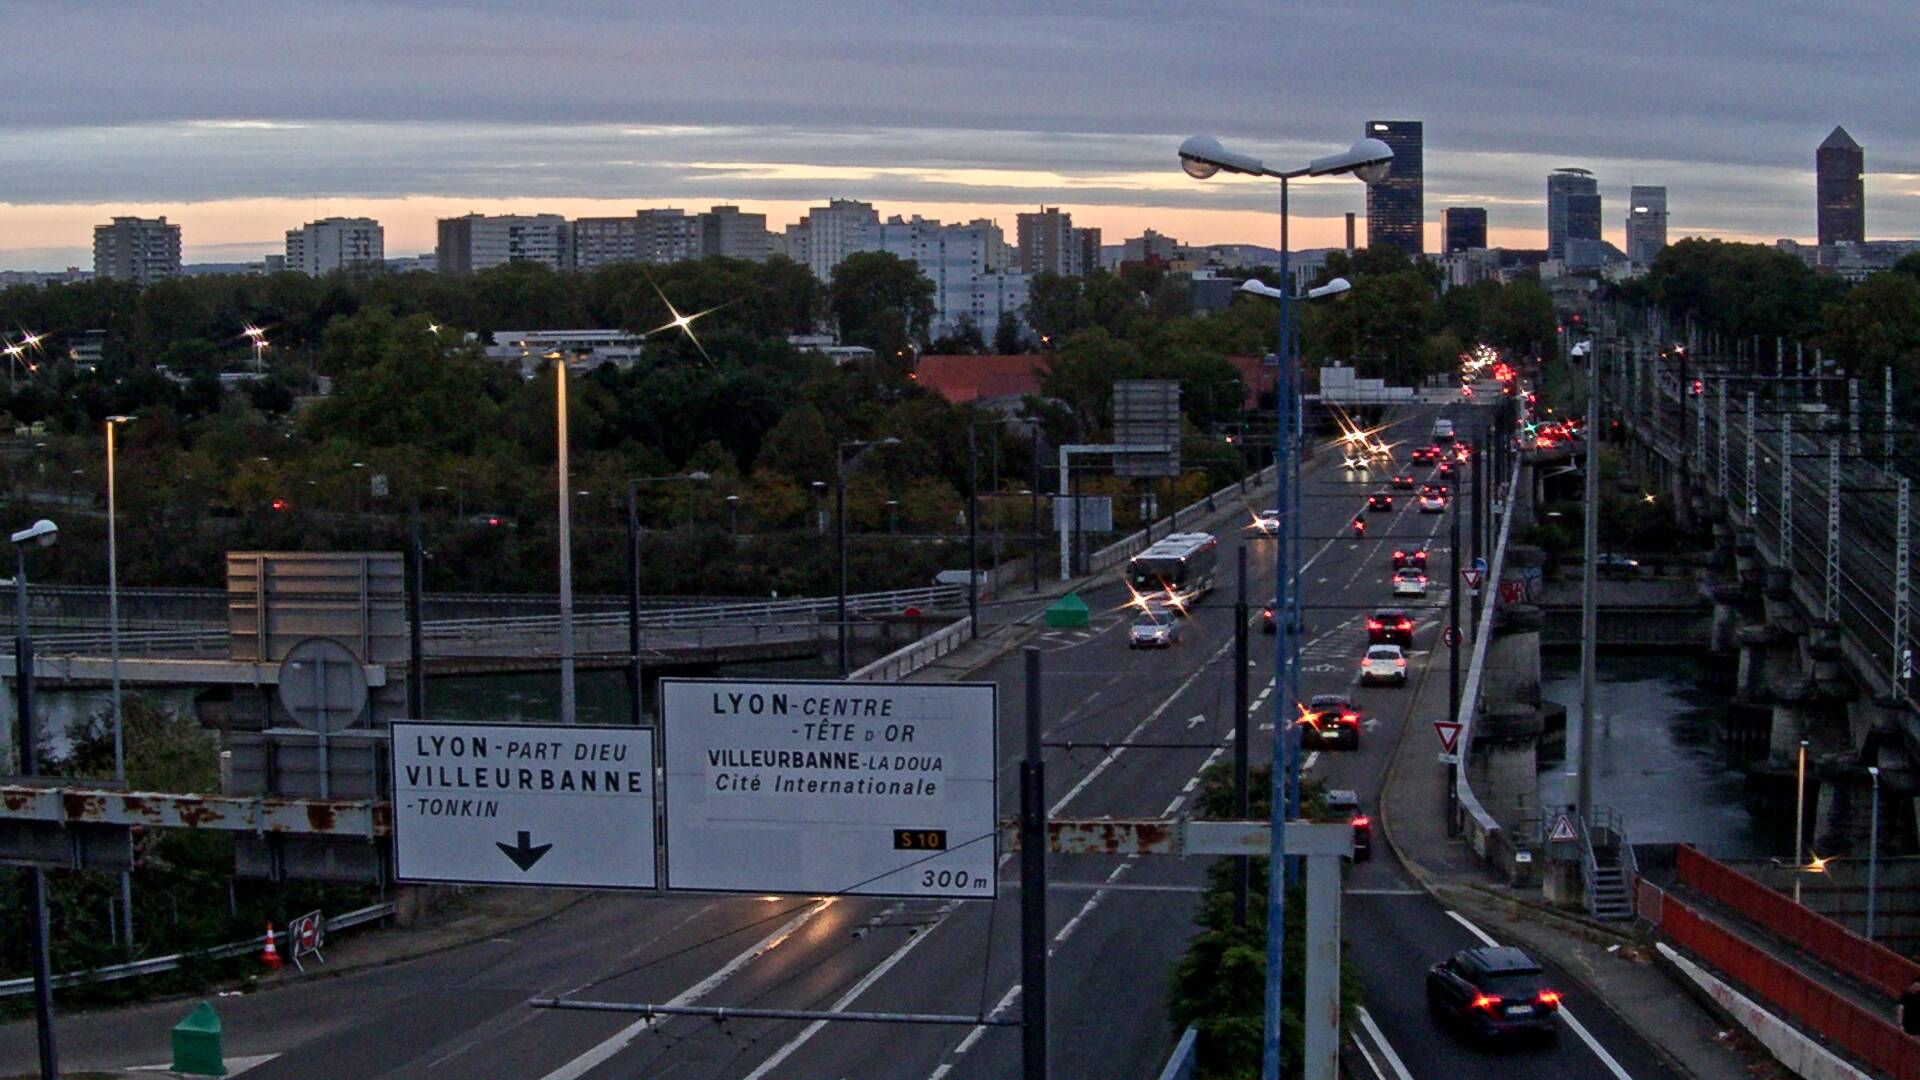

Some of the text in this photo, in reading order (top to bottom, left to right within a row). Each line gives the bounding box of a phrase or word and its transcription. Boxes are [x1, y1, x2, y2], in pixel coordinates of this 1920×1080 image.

[574, 743, 627, 762] DIEU
[894, 756, 943, 772] DOUA
[406, 765, 642, 793] VILLEURBANNE
[716, 773, 936, 796] Cité Internationale
[407, 798, 499, 818] -TONKIN
[922, 870, 988, 889] 300 m
